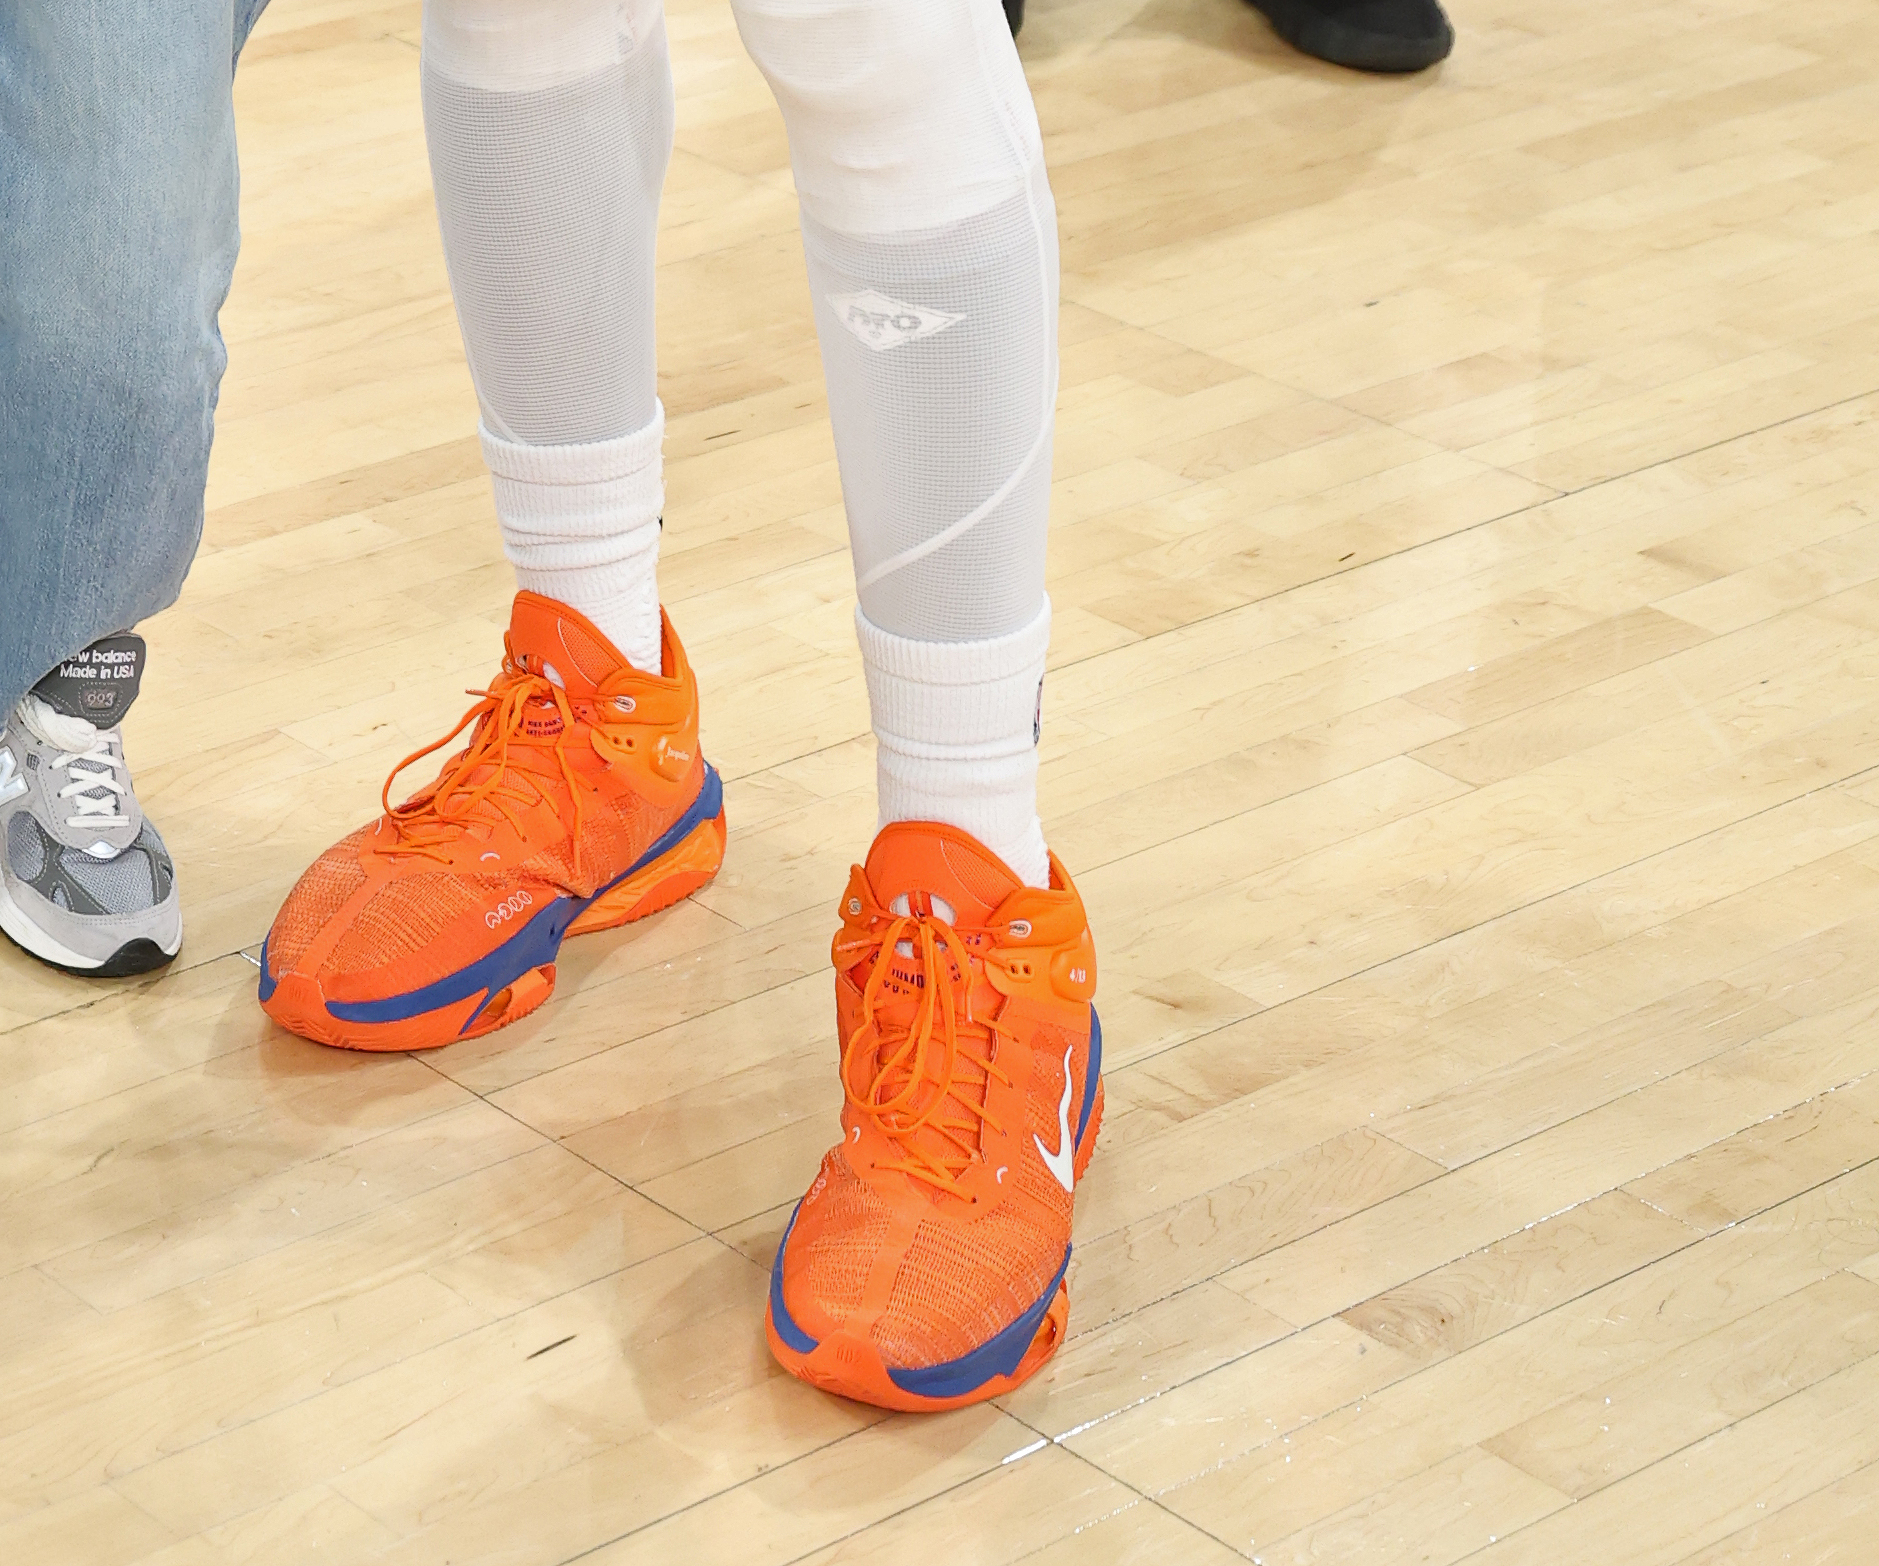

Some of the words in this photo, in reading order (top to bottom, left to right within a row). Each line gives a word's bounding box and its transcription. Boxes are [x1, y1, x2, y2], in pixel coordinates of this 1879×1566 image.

[92, 649, 137, 664] balance
[59, 664, 97, 679] Made
[100, 664, 111, 680] in
[113, 664, 134, 679] USA
